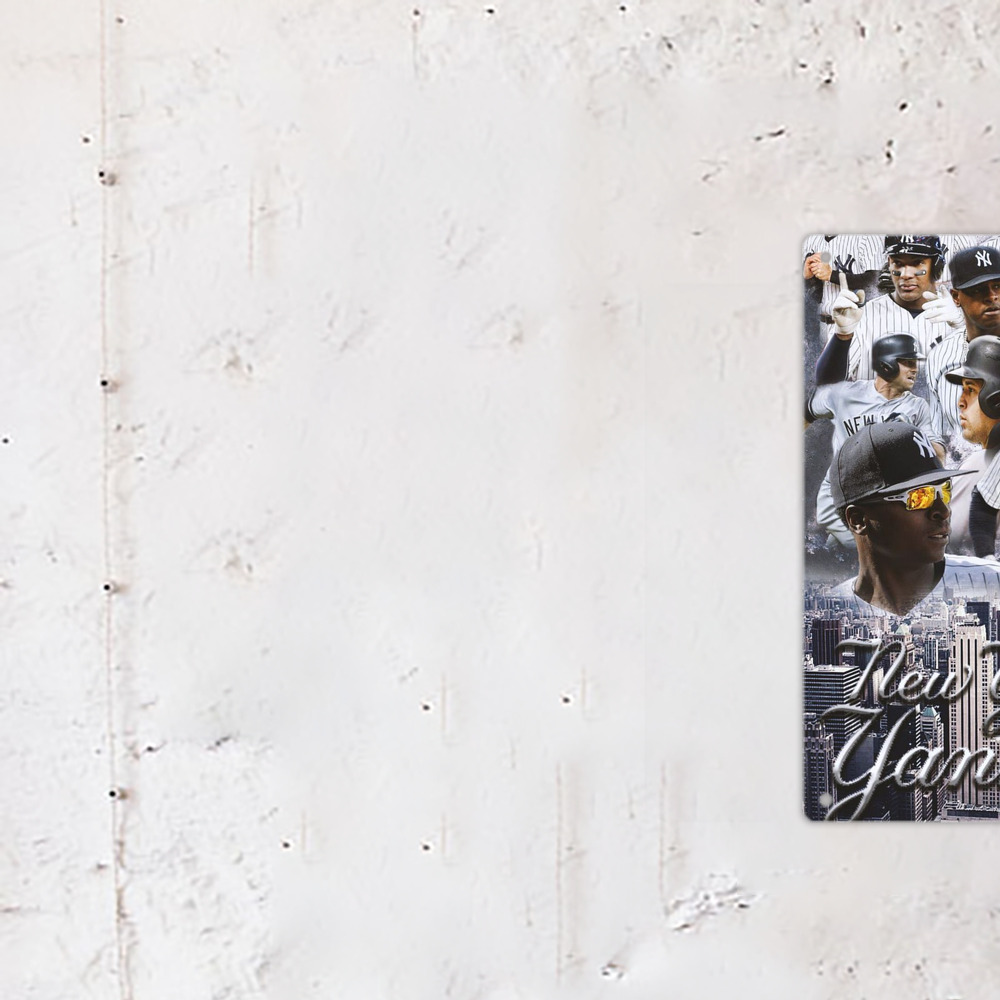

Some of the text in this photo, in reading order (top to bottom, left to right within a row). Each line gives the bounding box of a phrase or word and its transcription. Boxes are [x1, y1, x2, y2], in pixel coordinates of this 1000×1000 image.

[975, 250, 992, 267] NY
[913, 431, 936, 458] NY
[835, 639, 973, 702] New
